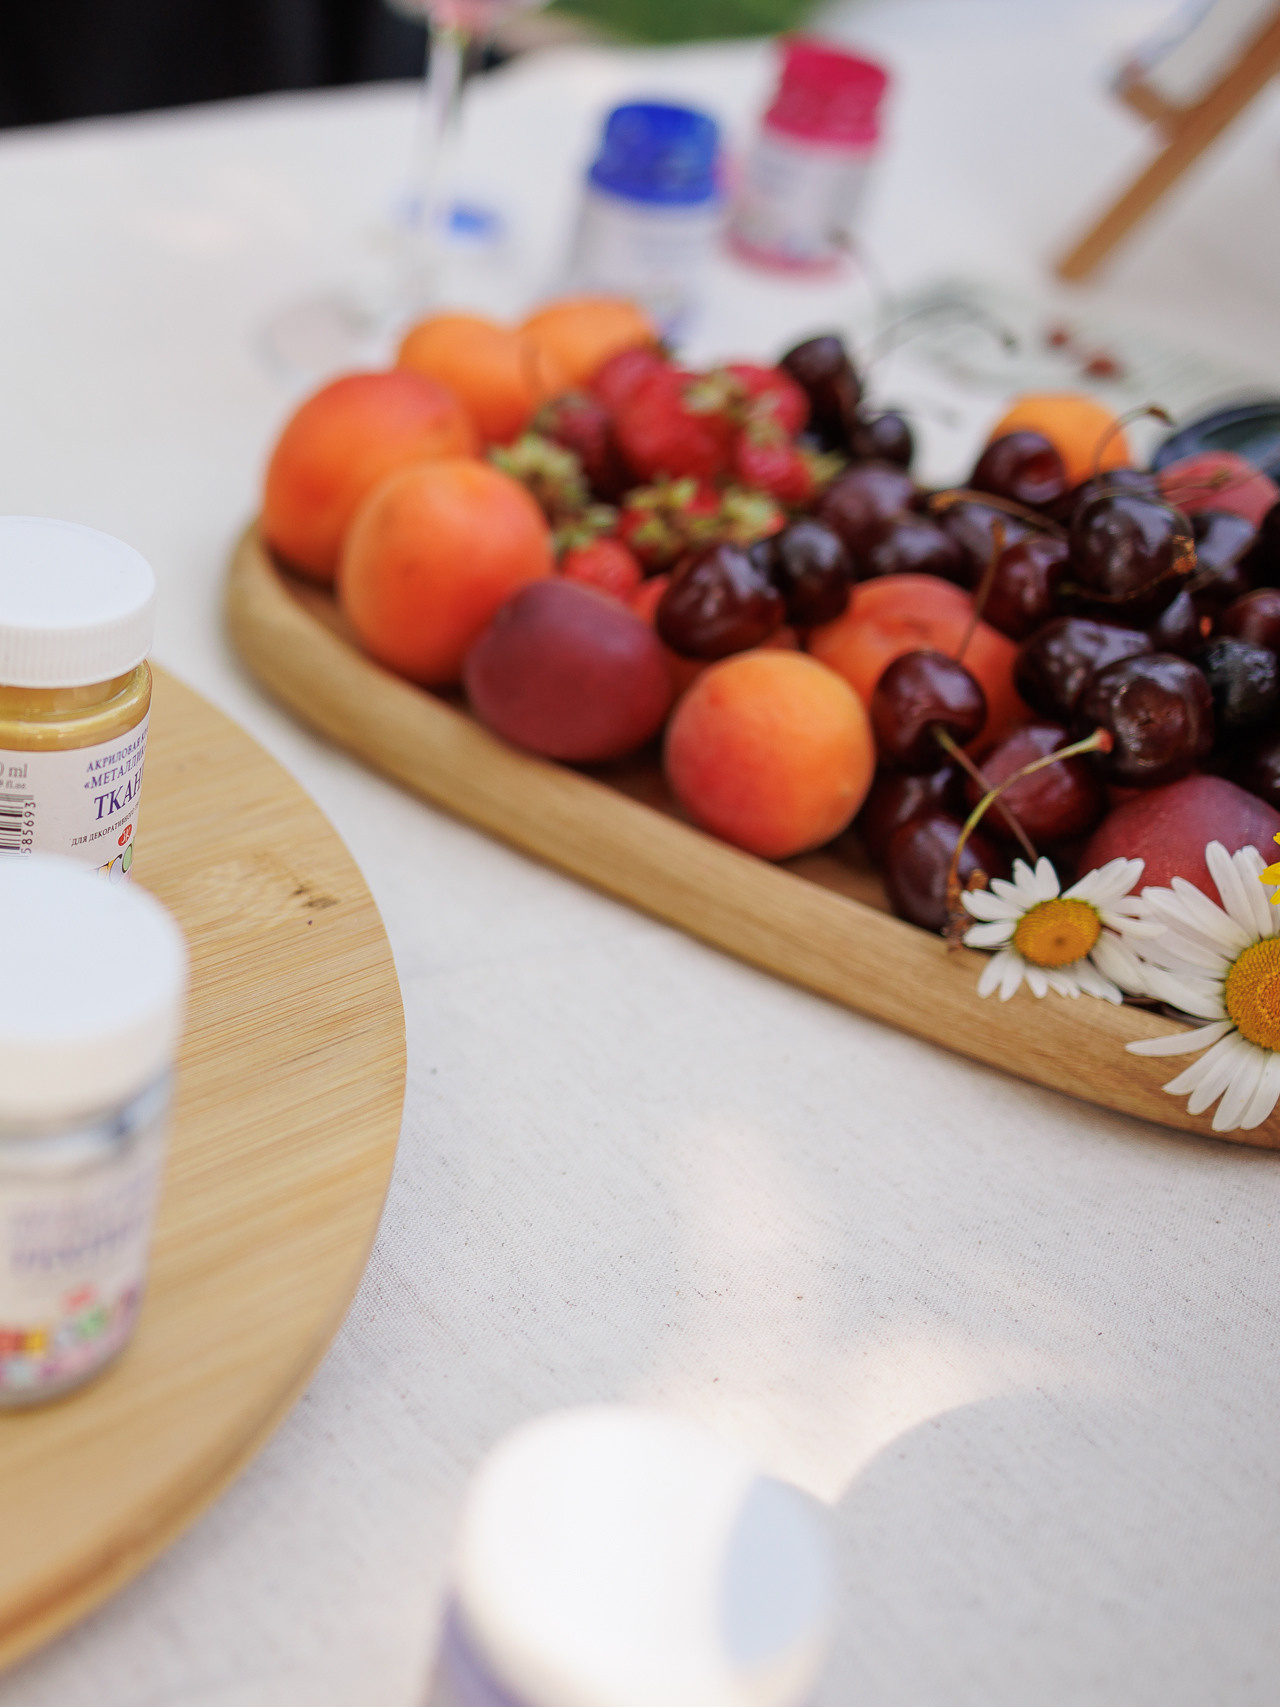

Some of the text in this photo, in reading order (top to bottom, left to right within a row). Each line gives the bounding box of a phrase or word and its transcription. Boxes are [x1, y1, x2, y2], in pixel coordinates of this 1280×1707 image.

[86, 737, 140, 773] АКРИЛОВАЯ
[8, 763, 28, 778] ml
[70, 835, 88, 847] ДЛЯ
